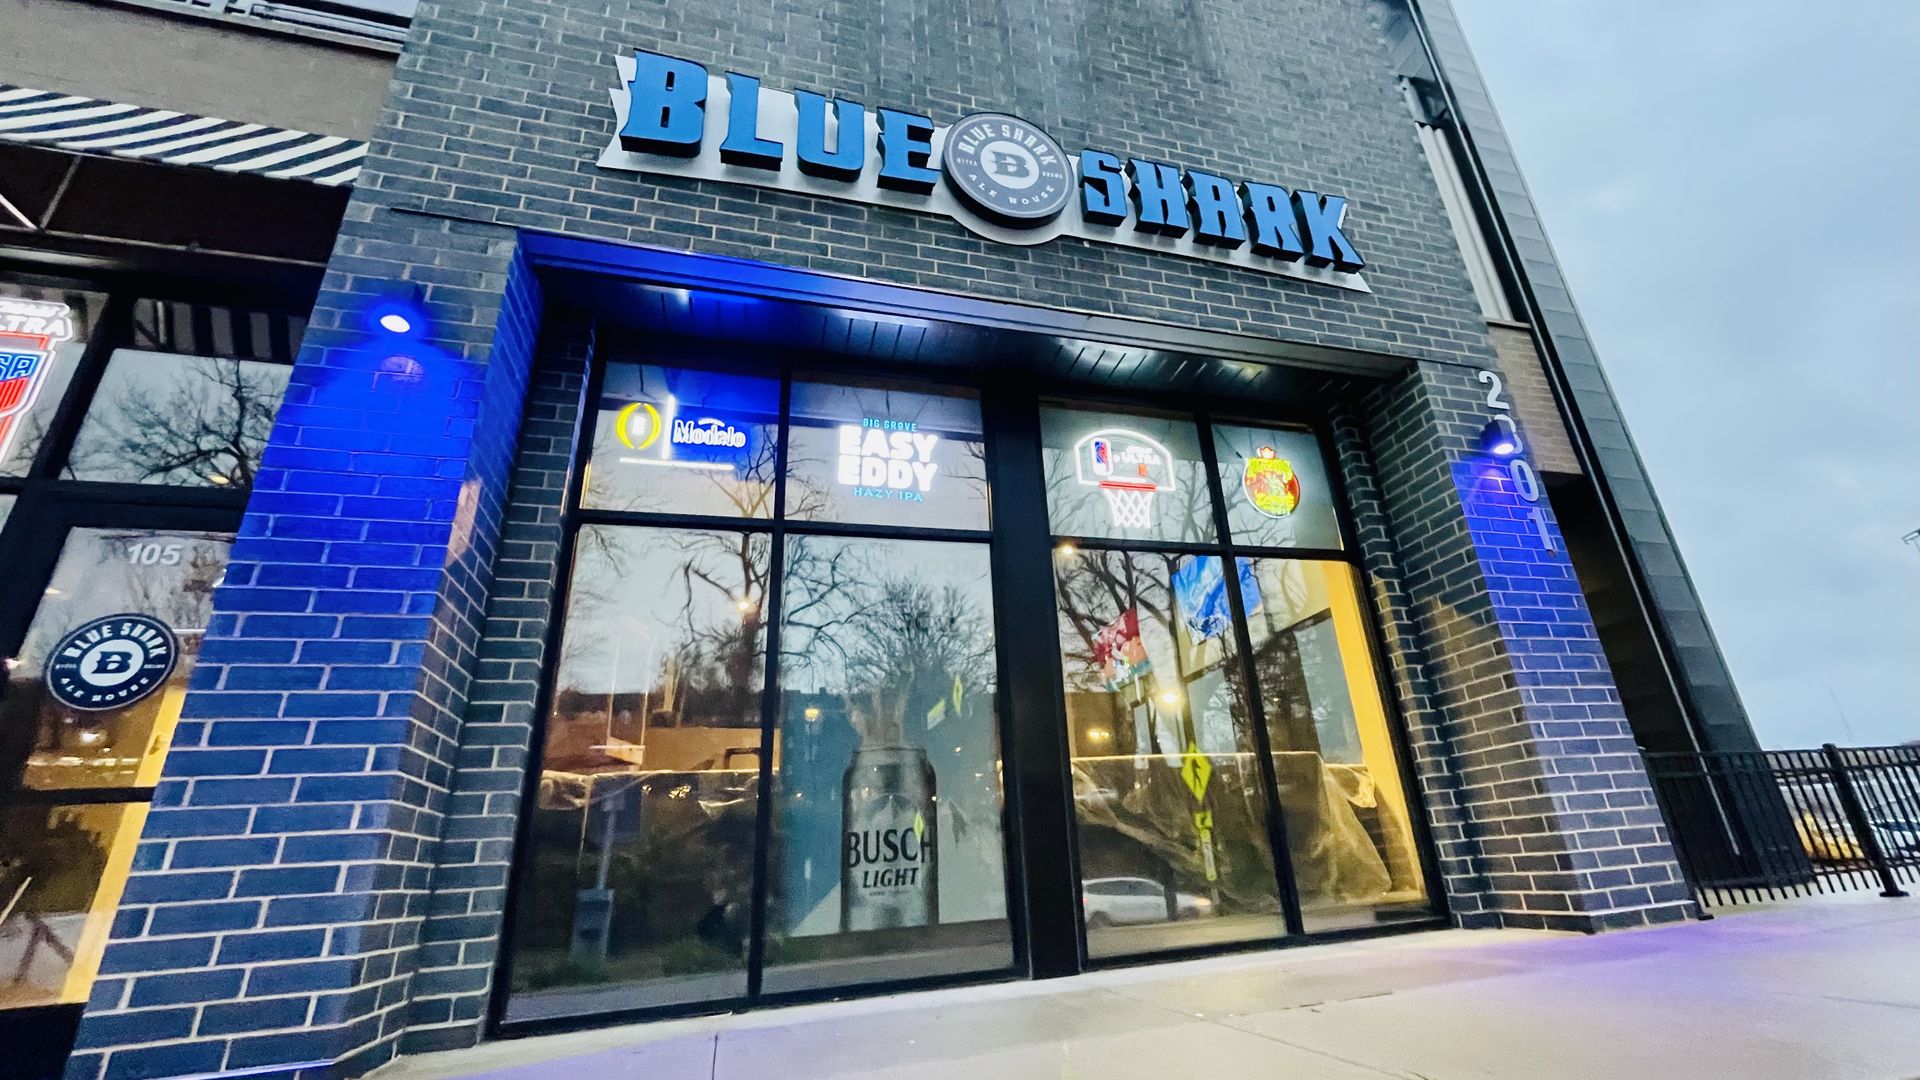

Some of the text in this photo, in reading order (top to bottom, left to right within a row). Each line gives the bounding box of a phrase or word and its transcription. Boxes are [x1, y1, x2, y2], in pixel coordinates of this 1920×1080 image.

[619, 48, 1365, 274] BLUE SHARK
[957, 124, 1057, 165] BLUE SHARK
[1008, 185, 1054, 205] HOUSE
[673, 419, 746, 448] Modelo
[863, 418, 918, 432] BIG GROVE
[839, 425, 938, 462] EASY
[839, 454, 938, 492] EDDY
[853, 487, 923, 502] HAZY IPA
[127, 542, 182, 565] 105
[63, 622, 168, 659] BLUE SHARK
[846, 827, 934, 869] BUSCH
[862, 867, 919, 889] LIGHT
